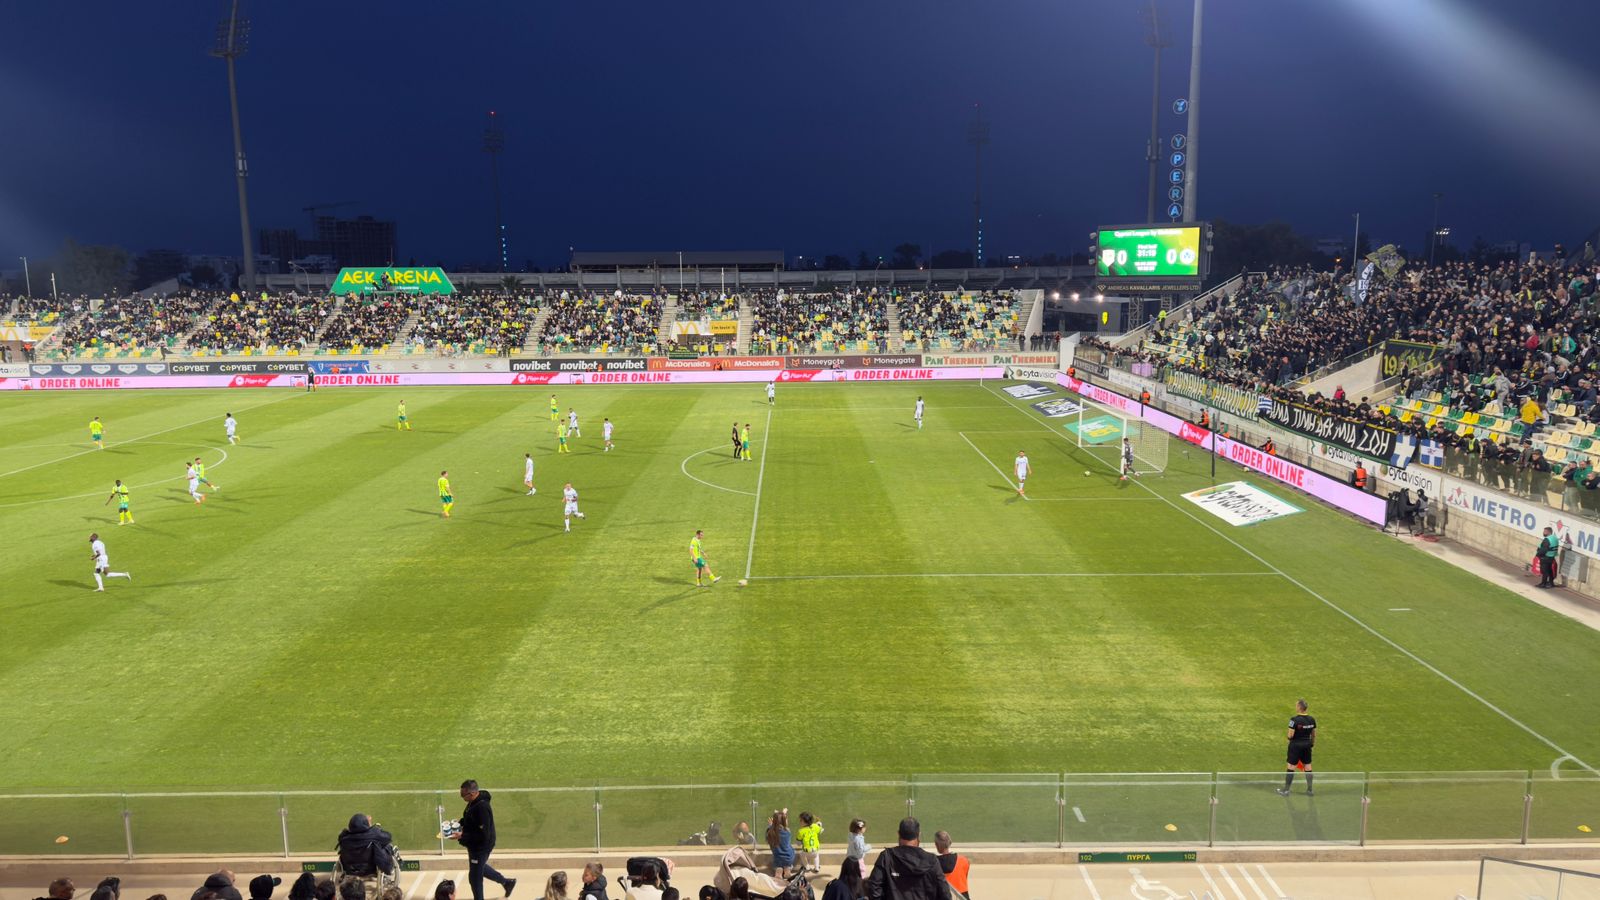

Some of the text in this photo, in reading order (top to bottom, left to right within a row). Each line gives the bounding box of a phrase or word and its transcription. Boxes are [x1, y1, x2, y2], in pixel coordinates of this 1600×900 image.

[1117, 250, 1127, 265] 0
[1166, 249, 1177, 264] 0
[342, 271, 378, 284] AEK
[513, 360, 551, 370] novibet
[560, 360, 598, 370] novibet
[607, 359, 644, 369] novibet
[803, 358, 845, 366] Moneygate
[874, 357, 916, 365] Moneygate
[314, 374, 400, 385] ORDER ONLINE
[591, 372, 671, 383] ORDER ONLINE
[854, 370, 890, 379] ORDER
[893, 369, 933, 379] ONLINE
[40, 378, 76, 388] ORDER
[80, 378, 121, 387] ONLINE
[1231, 444, 1305, 487] ORDER ONLINE
[1389, 466, 1433, 492] cytavision
[1472, 495, 1537, 531] METRO
